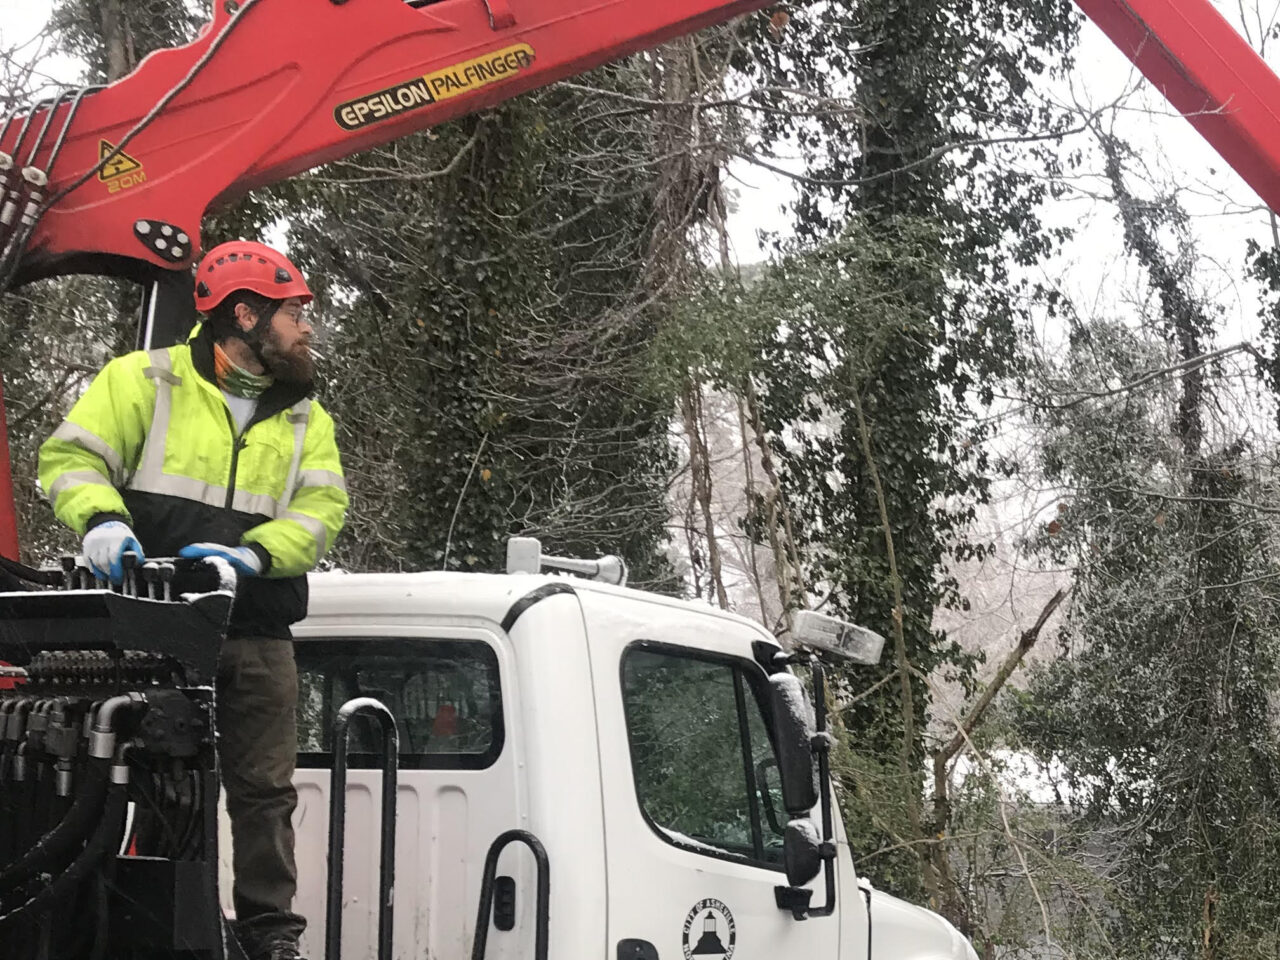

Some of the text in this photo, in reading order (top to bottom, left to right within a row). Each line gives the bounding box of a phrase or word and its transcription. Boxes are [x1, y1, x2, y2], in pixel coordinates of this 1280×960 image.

[340, 49, 532, 126] EPSILON PALFINGER
[107, 171, 147, 194] 20M
[683, 910, 696, 934] CITY
[706, 899, 736, 935] ASHEVILLE
